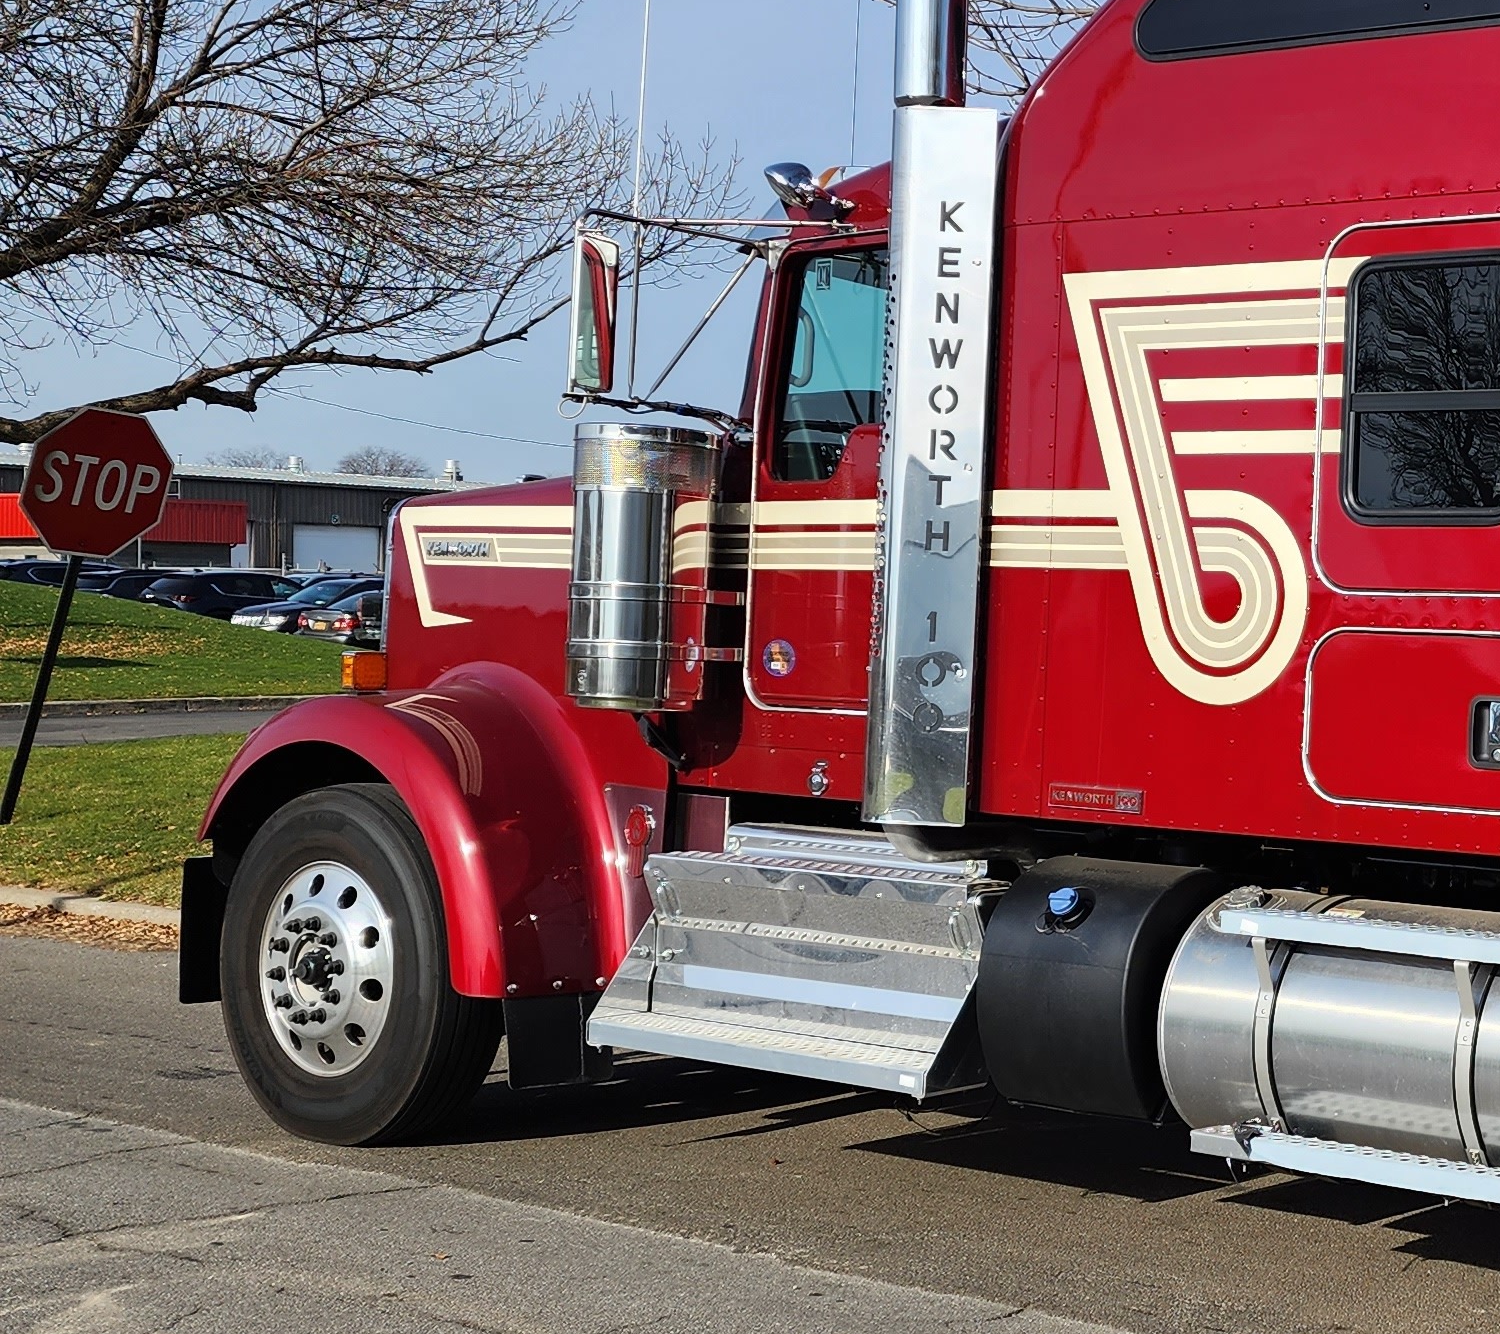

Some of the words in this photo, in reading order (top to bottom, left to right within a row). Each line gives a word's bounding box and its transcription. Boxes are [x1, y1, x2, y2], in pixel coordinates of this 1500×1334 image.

[924, 200, 965, 552] KENWORTH
[34, 450, 161, 514] STOP
[913, 611, 947, 733] 100
[1052, 789, 1114, 805] KENWORTH
